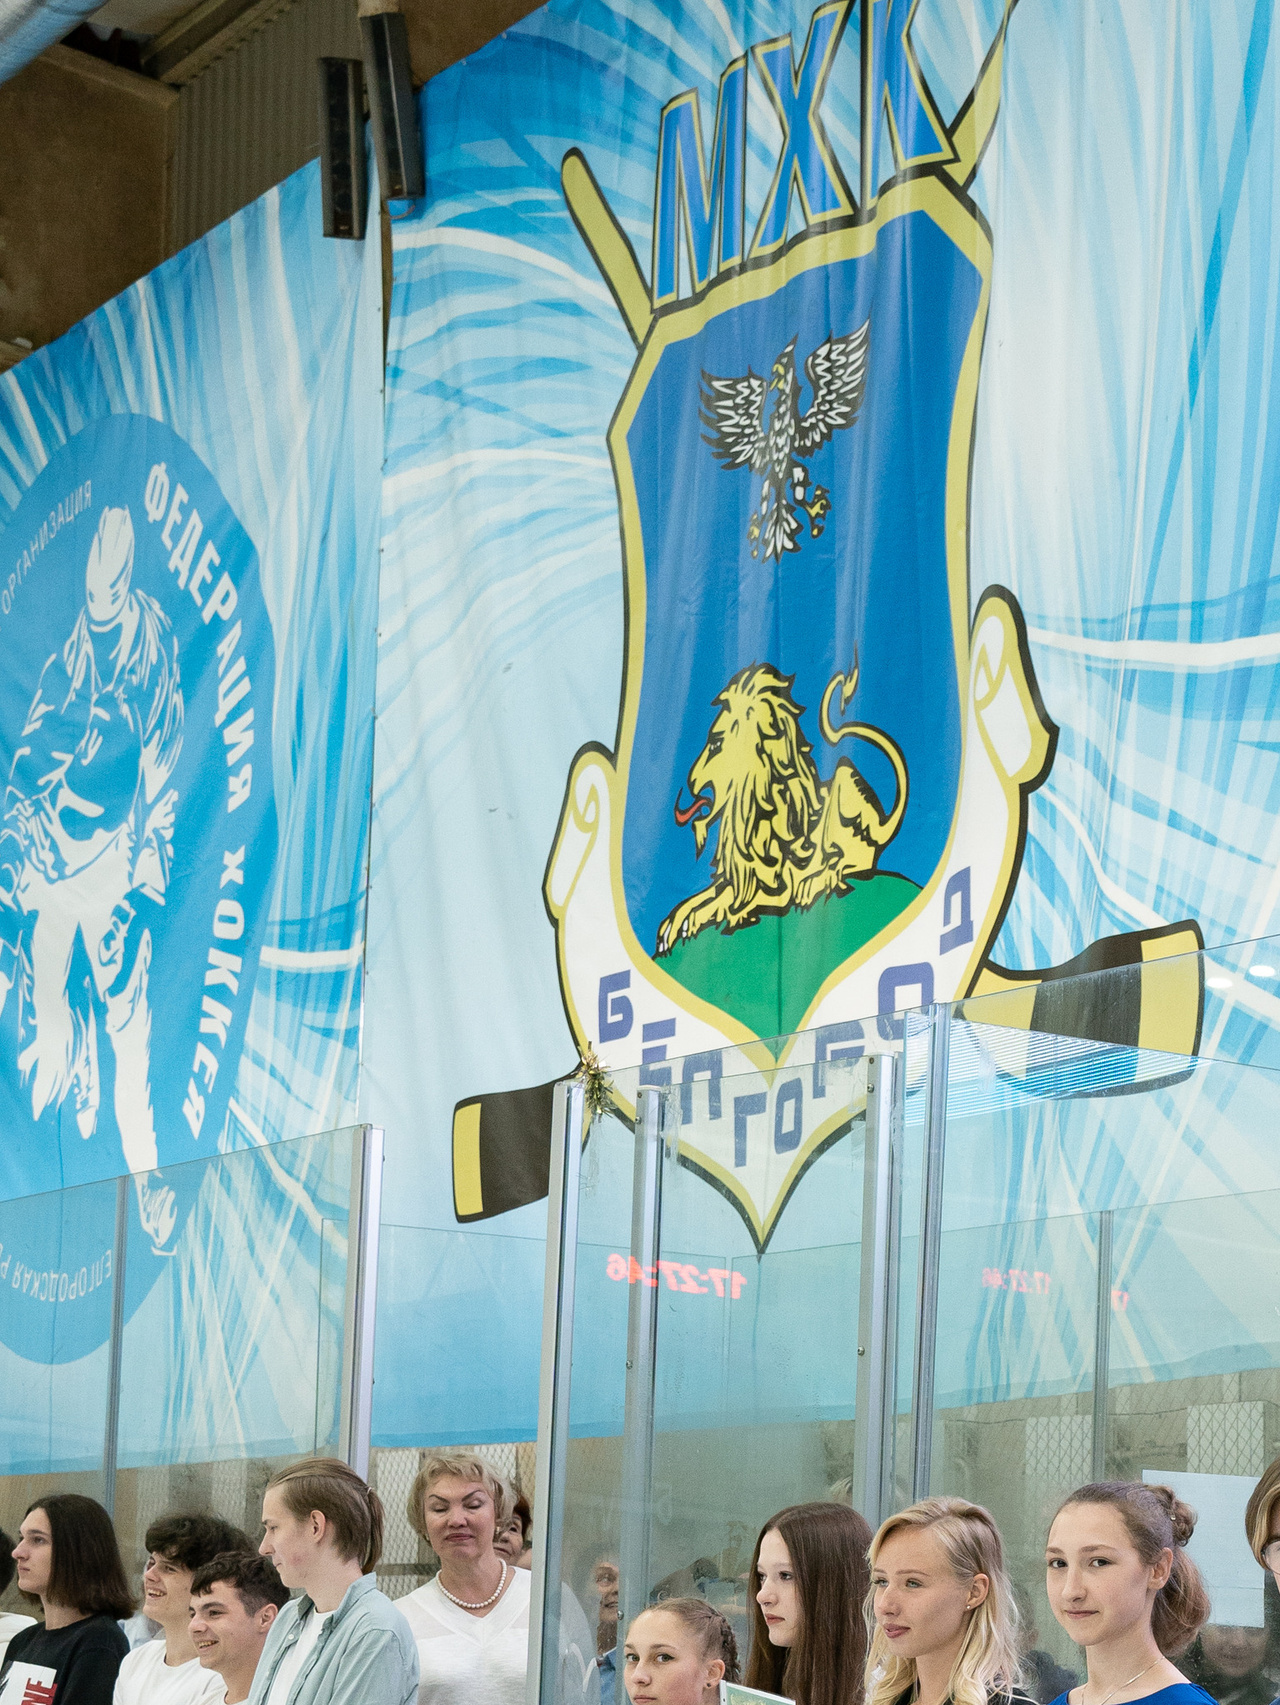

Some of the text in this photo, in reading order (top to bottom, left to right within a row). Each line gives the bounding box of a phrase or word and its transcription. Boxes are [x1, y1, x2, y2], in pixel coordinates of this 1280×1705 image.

[650, 0, 962, 313] МХК
[1, 479, 92, 615] ОРГАНИЗАЦИЯ
[144, 461, 255, 1142] ФЕДЕРАЦИЯ ХОККЕЯ
[11, 1249, 113, 1302] ЕЛГОРОДСКАЯ
